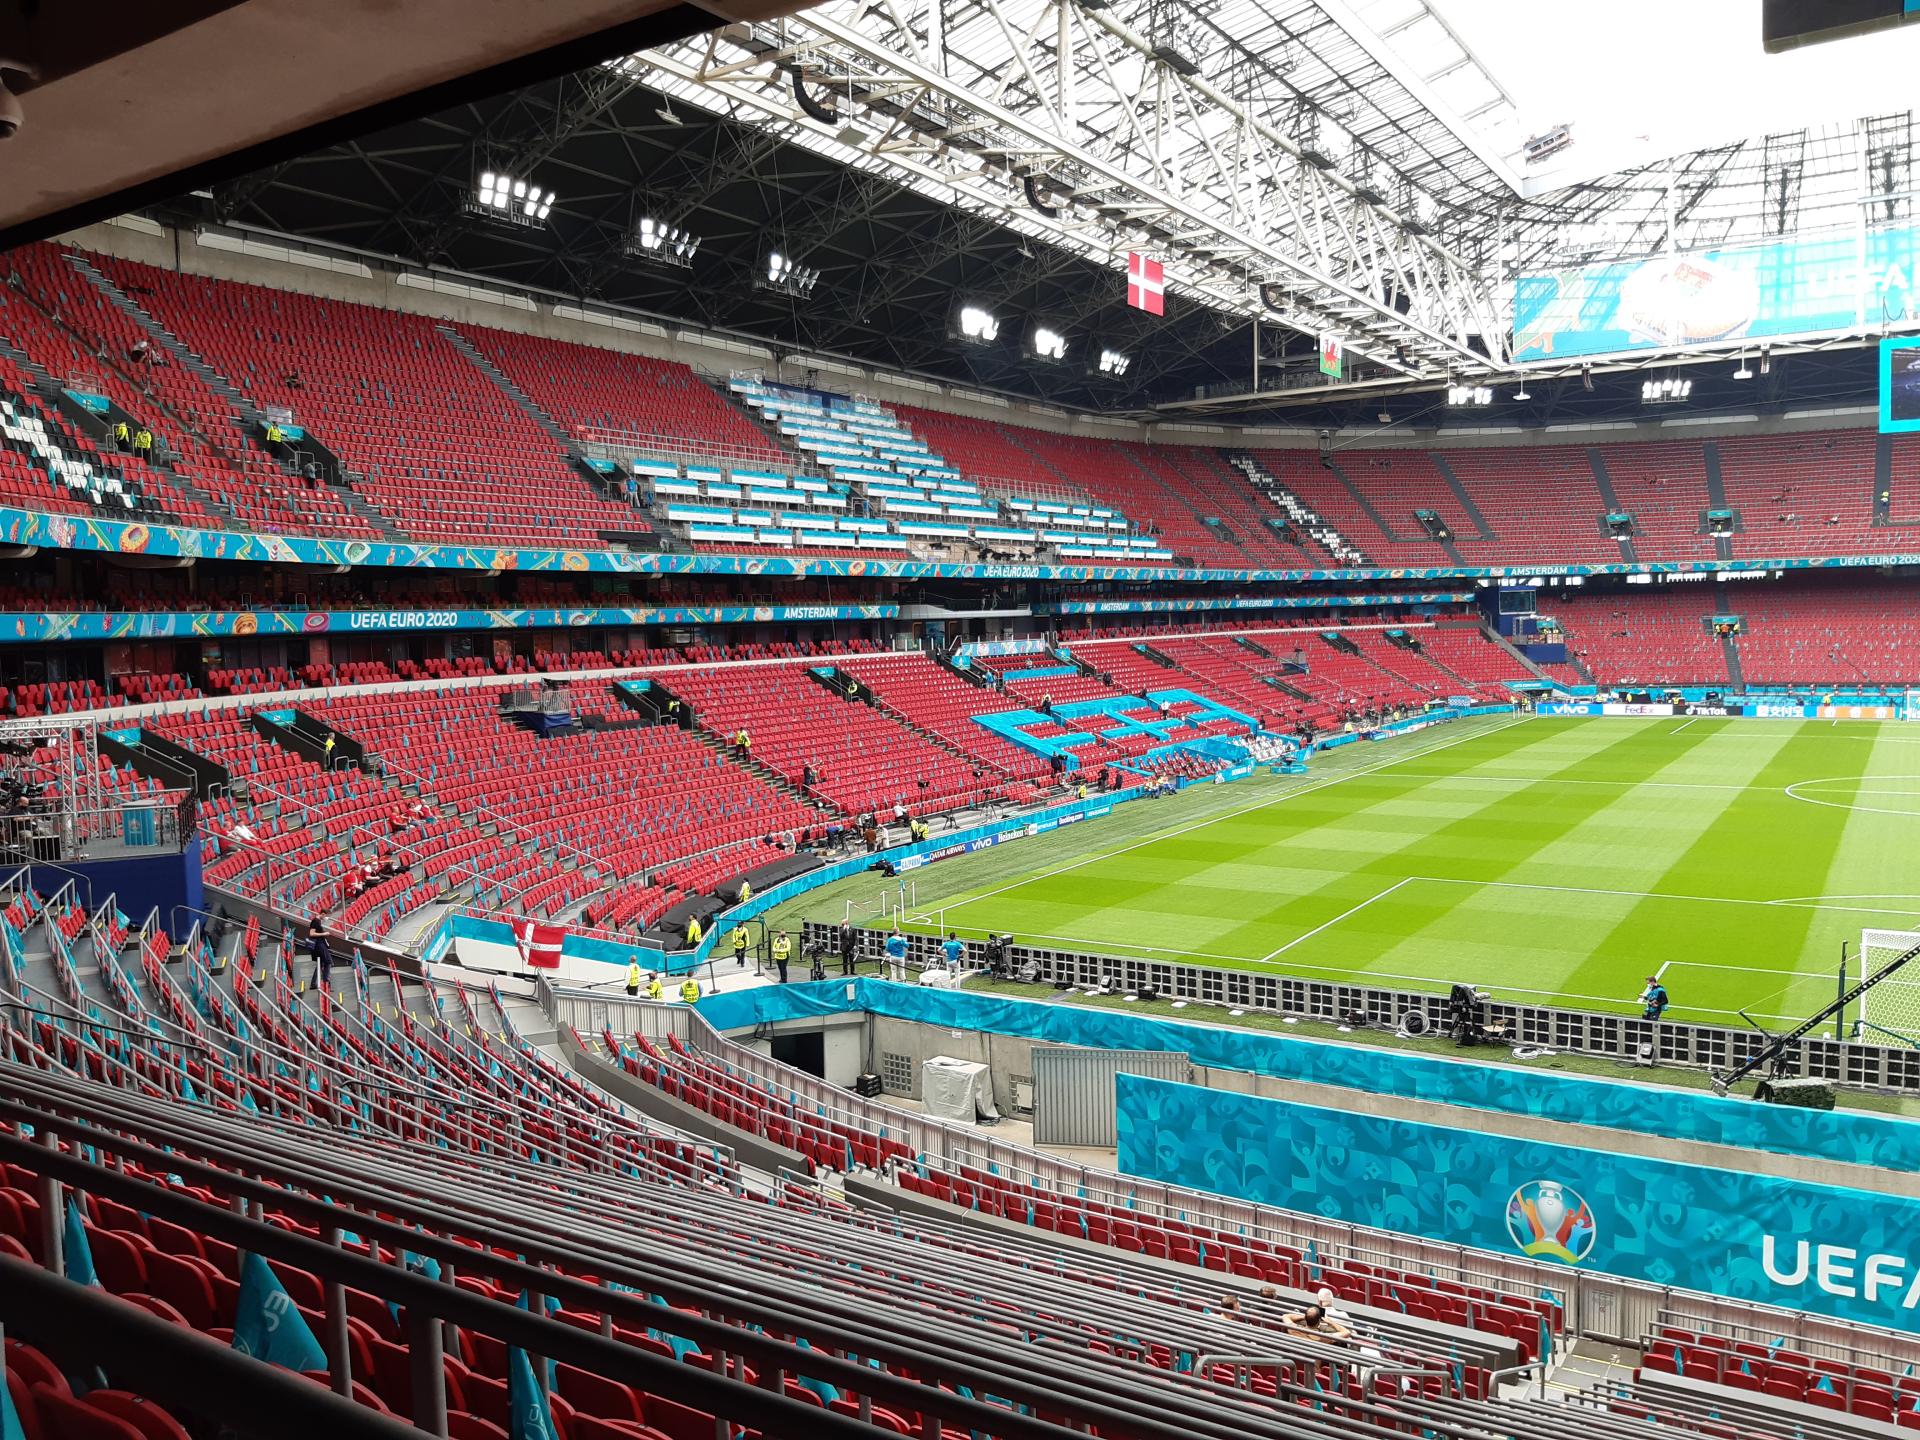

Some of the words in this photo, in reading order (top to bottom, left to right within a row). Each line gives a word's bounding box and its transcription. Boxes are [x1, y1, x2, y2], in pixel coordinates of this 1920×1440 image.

[1839, 557, 1867, 566] UEFA
[1868, 556, 1897, 565] EURO
[1898, 555, 1920, 565] 202
[1022, 566, 1040, 578] 2020
[1510, 566, 1568, 576] AMSTERDAM
[783, 607, 838, 619] AMSTERDAM
[351, 613, 387, 628] UEFA
[389, 612, 425, 627] EURO
[426, 612, 458, 627] 2020
[1552, 703, 1589, 714] vivo
[1624, 705, 1654, 714] FedEx
[1695, 706, 1728, 716] TikTok
[946, 843, 966, 856] AIRWAYS
